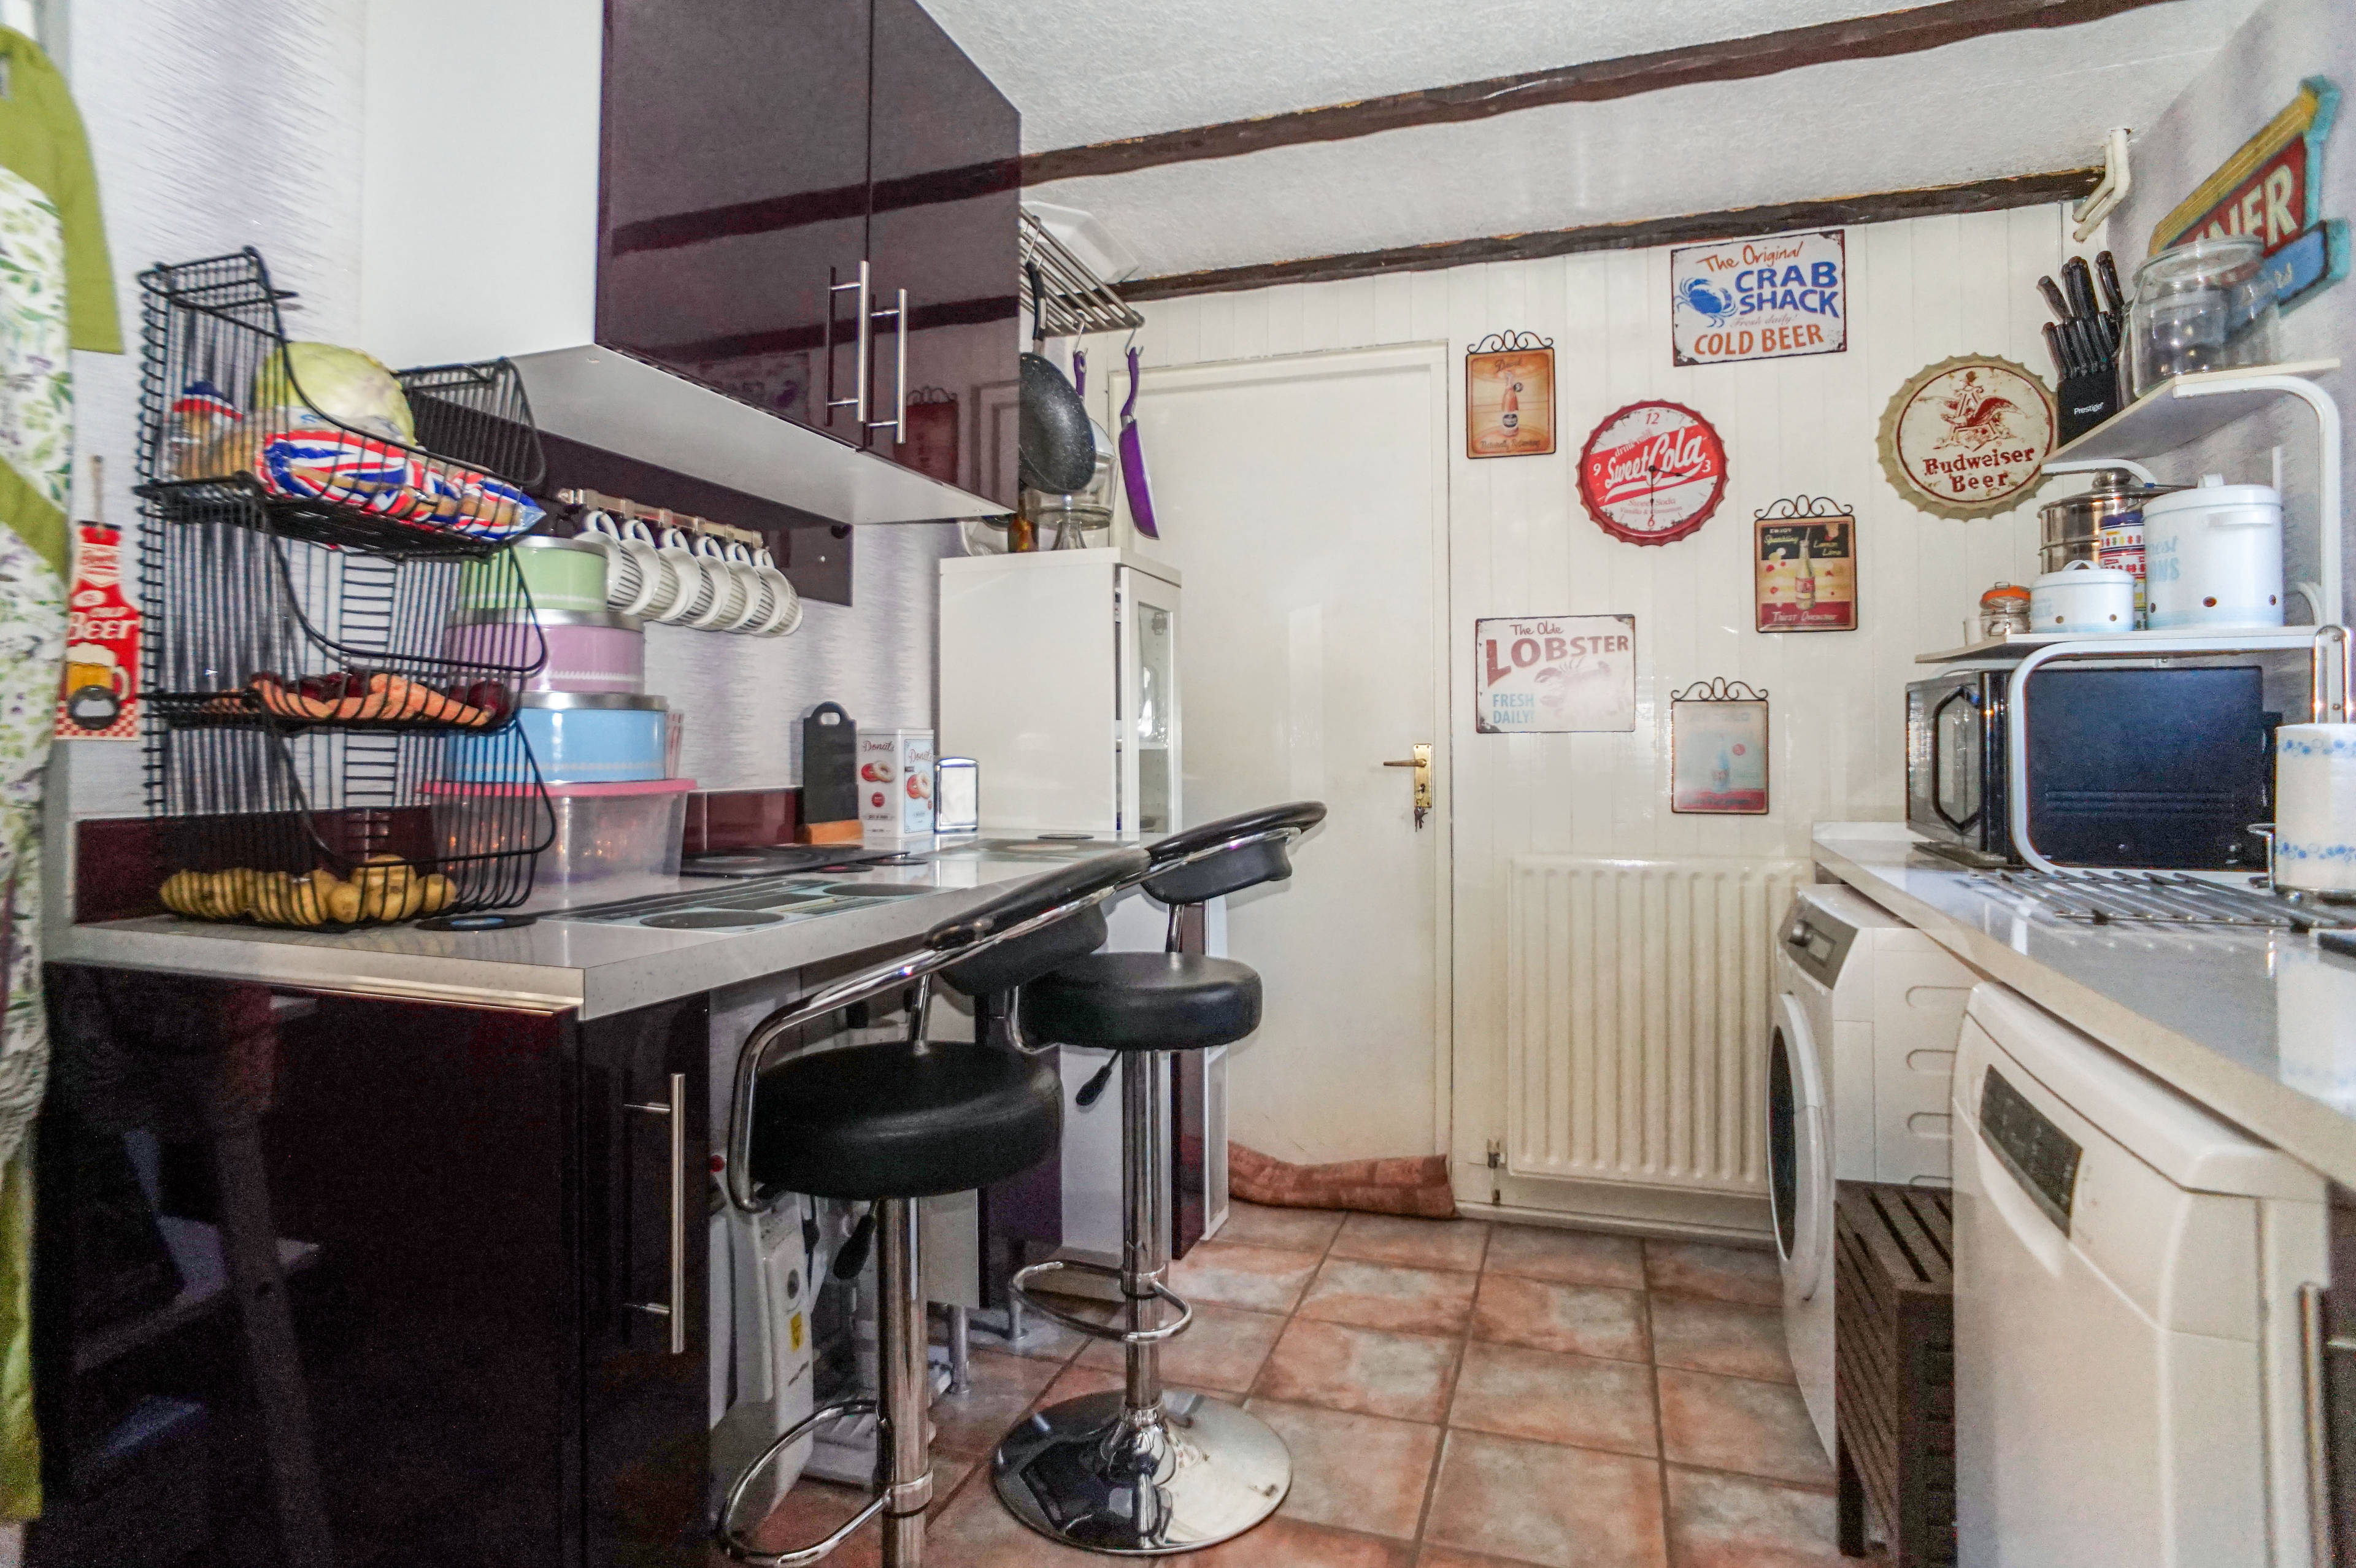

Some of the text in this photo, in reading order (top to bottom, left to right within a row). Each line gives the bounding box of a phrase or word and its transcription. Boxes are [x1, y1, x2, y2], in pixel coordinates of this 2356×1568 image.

[1696, 241, 1804, 272] The Original
[1735, 261, 1838, 293] CRAB
[1739, 289, 1839, 318] SHACK
[1694, 324, 1824, 355] COLD BEER
[1646, 413, 1660, 425] 12
[1604, 426, 1706, 489] Sweet Cola
[1701, 459, 1711, 472] 3
[1923, 447, 2035, 476] Budweiser
[1593, 463, 1601, 476] 9
[1950, 472, 2008, 493] Beer
[1647, 517, 1655, 527] 6
[1509, 621, 1564, 636] The Olde
[1486, 635, 1629, 688] LOBSTER
[1493, 693, 1534, 707] FRESH
[863, 740, 895, 752] Donuts
